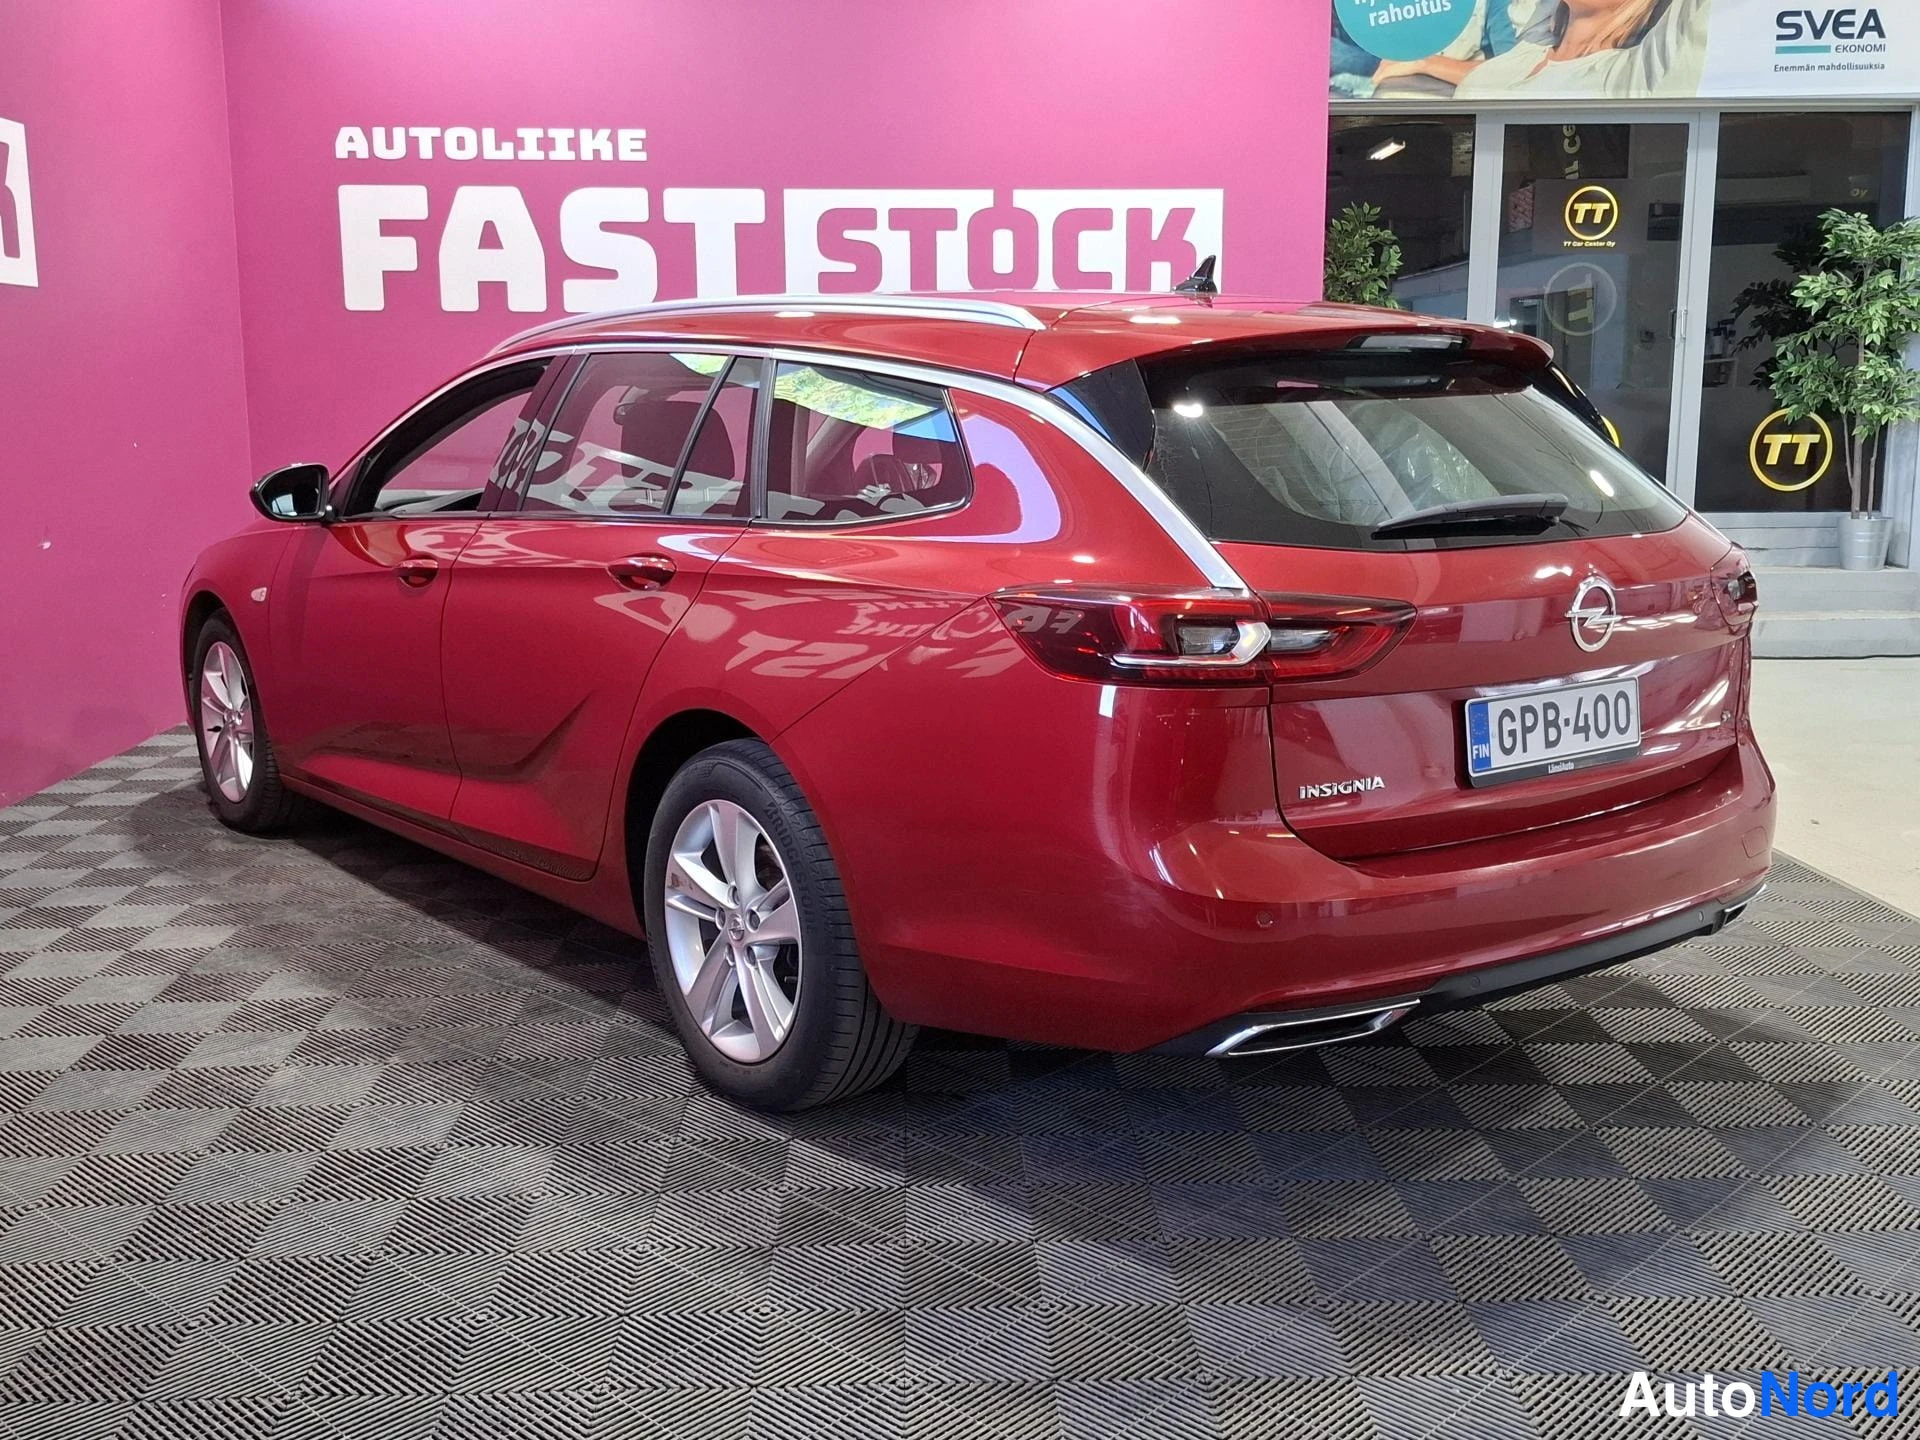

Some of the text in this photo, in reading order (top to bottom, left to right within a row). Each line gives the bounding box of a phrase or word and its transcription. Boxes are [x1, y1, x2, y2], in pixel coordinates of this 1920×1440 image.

[1368, 0, 1452, 27] rahoitus
[1775, 9, 1886, 41] SVEA
[1835, 43, 1886, 54] EKONOMI
[1774, 62, 1886, 72] Enemmän mahdollisuuksia
[335, 126, 648, 161] AUTOLIIKE
[1573, 203, 1610, 224] TT
[337, 184, 1198, 312] FAST STOCK
[1763, 433, 1821, 465] TT
[1498, 690, 1631, 756] GPB-400
[1472, 743, 1490, 760] FIN
[1299, 776, 1386, 799] INSIGNIA
